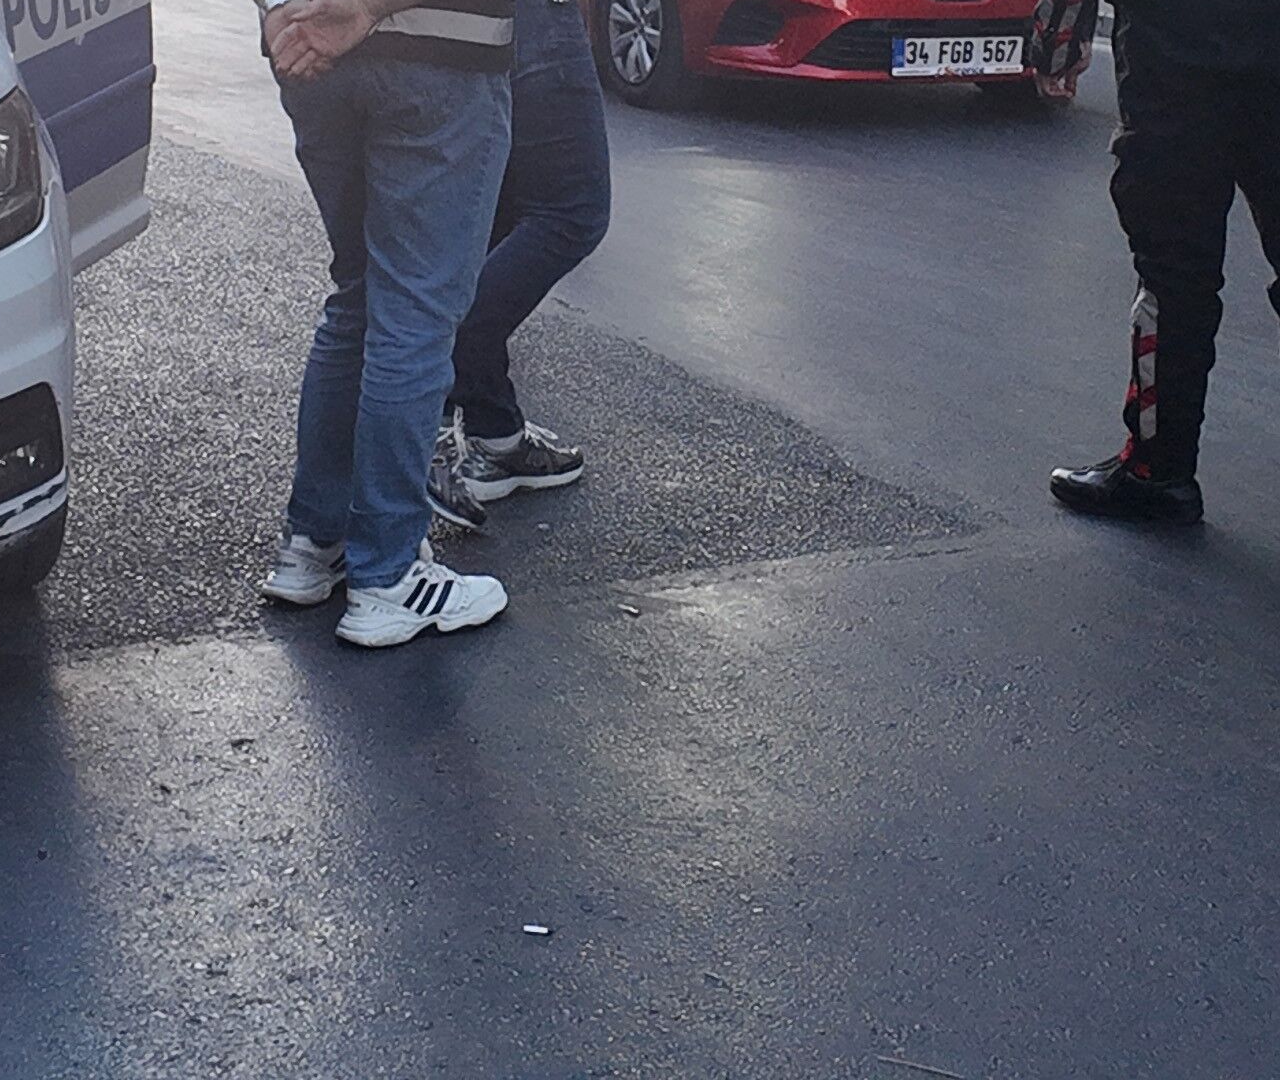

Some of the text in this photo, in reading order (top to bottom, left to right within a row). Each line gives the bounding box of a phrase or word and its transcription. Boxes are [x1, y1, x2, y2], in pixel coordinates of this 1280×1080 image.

[905, 39, 1019, 65] 34 FGB 567
